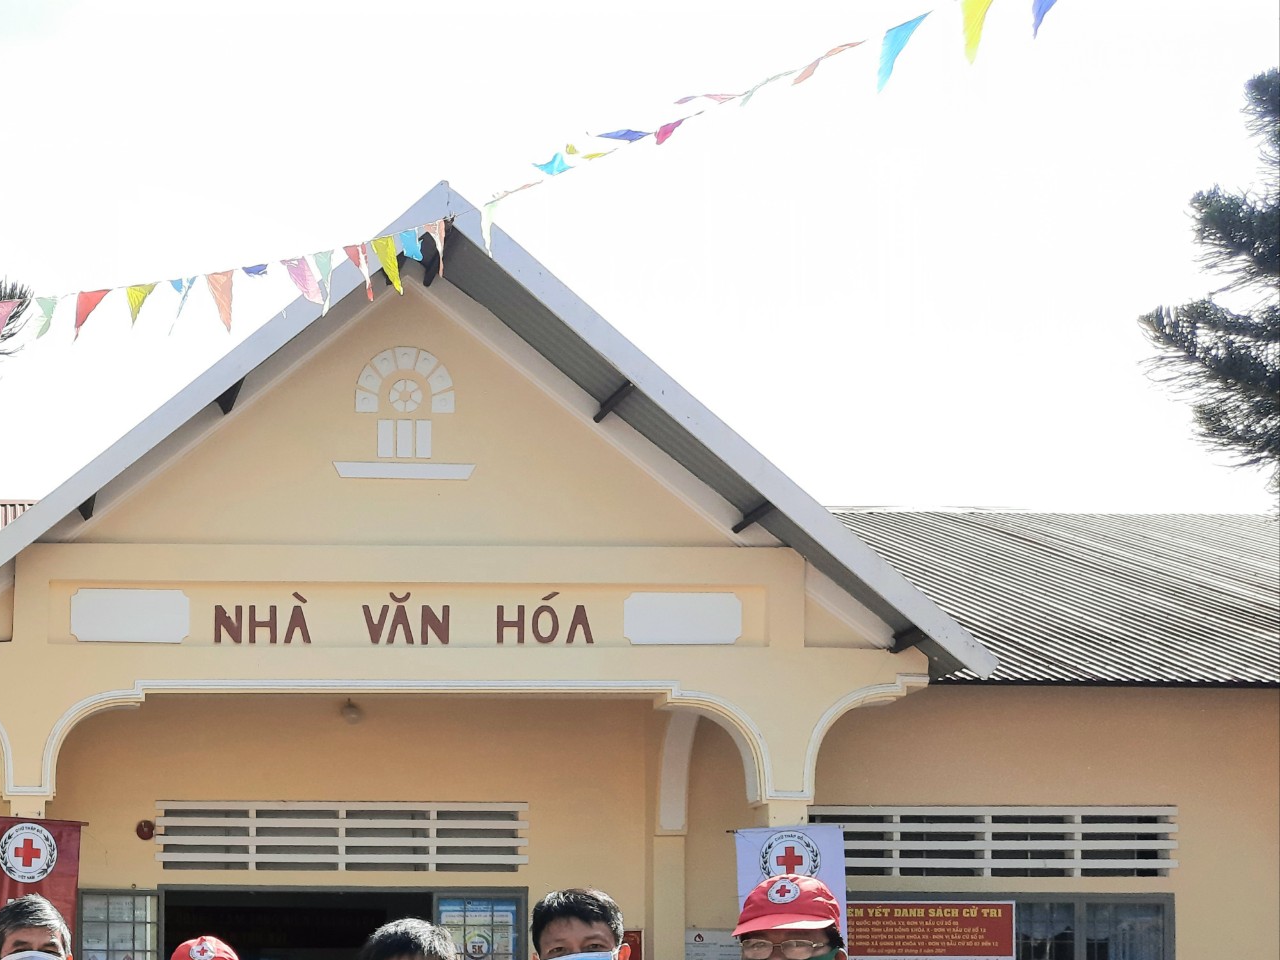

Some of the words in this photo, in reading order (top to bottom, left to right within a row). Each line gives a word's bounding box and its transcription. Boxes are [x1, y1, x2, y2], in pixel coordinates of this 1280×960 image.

[214, 592, 312, 645] NHÀ
[361, 592, 450, 646] VĂN
[496, 592, 595, 645] HÓA
[867, 905, 890, 917] YẾT
[894, 908, 924, 917] DANH
[928, 906, 958, 917] SÁCH
[963, 906, 978, 917] CỬ
[981, 908, 1002, 917] TRI
[472, 945, 484, 954] 5K
